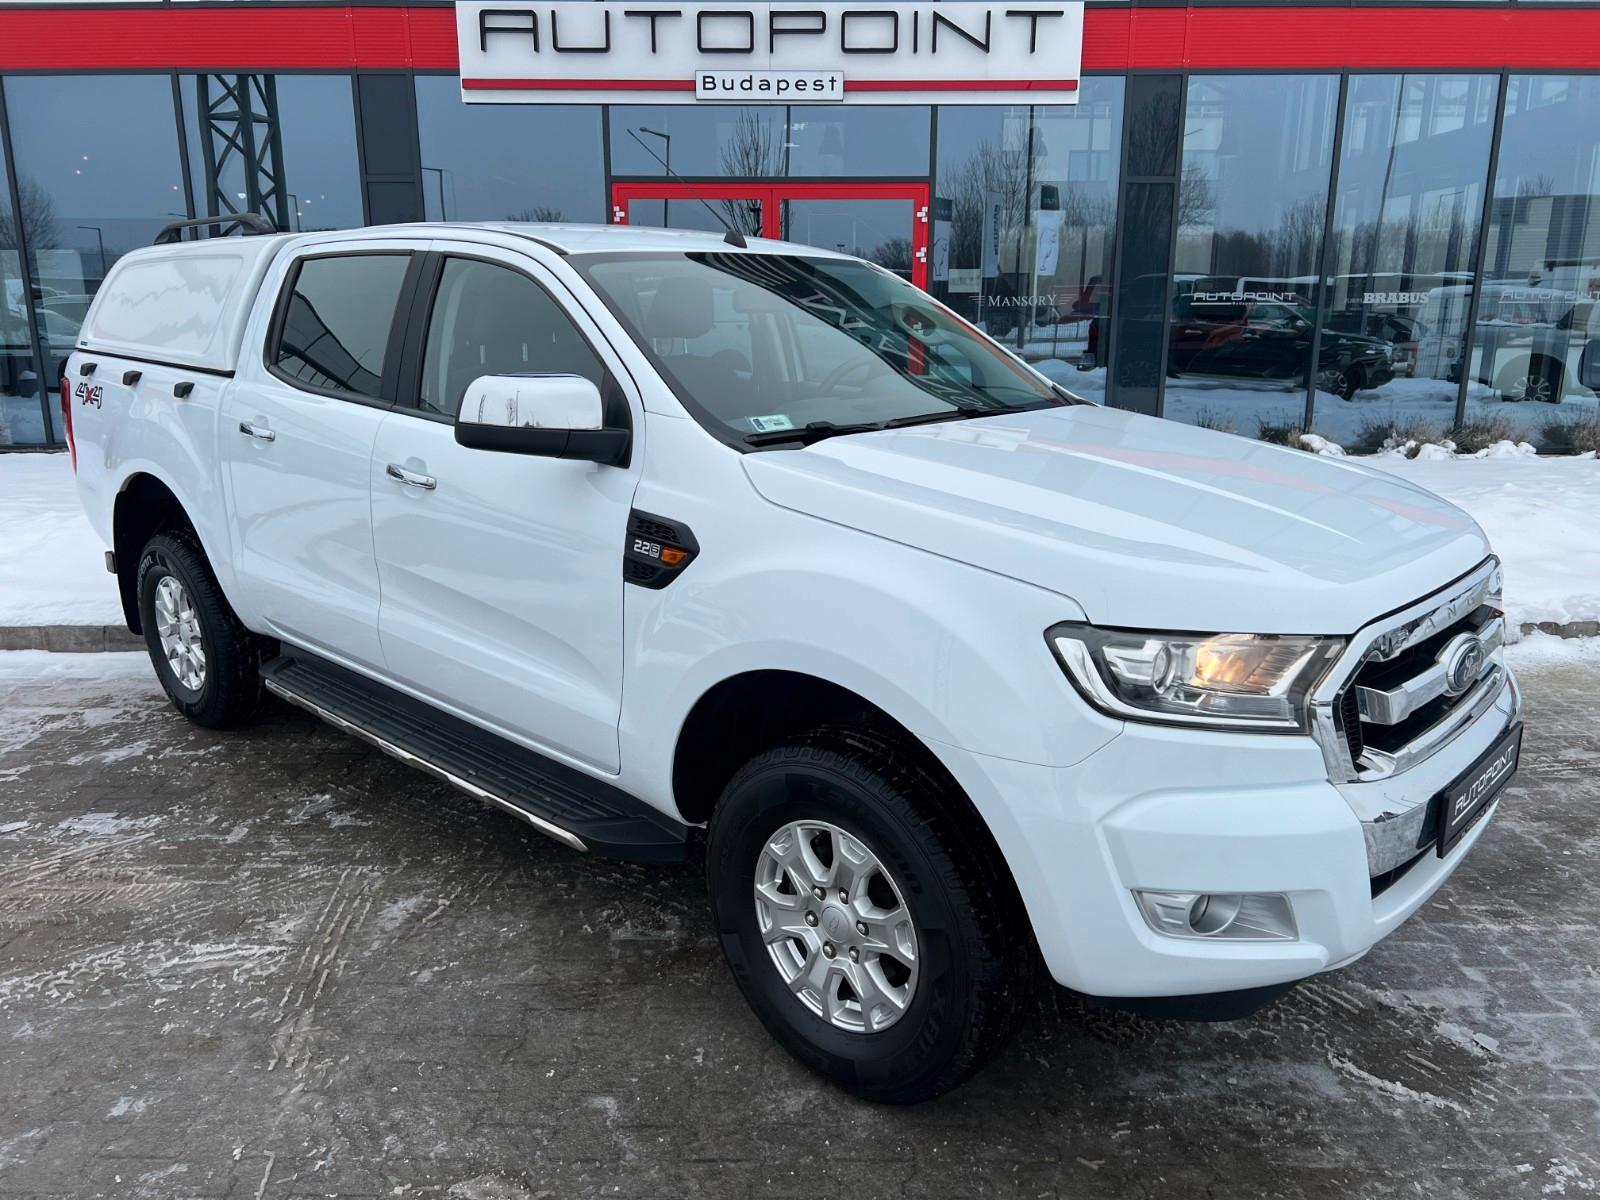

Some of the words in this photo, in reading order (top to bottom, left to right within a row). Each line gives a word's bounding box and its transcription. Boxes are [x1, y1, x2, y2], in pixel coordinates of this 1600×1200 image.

[478, 9, 1065, 54] AUTOPOINT
[701, 75, 838, 93] Budapest
[988, 294, 1058, 307] MANSORY
[1193, 291, 1297, 301] AUTOPOINT
[1363, 292, 1430, 304] BRABUS
[1454, 744, 1515, 817] AUTOPOINT
